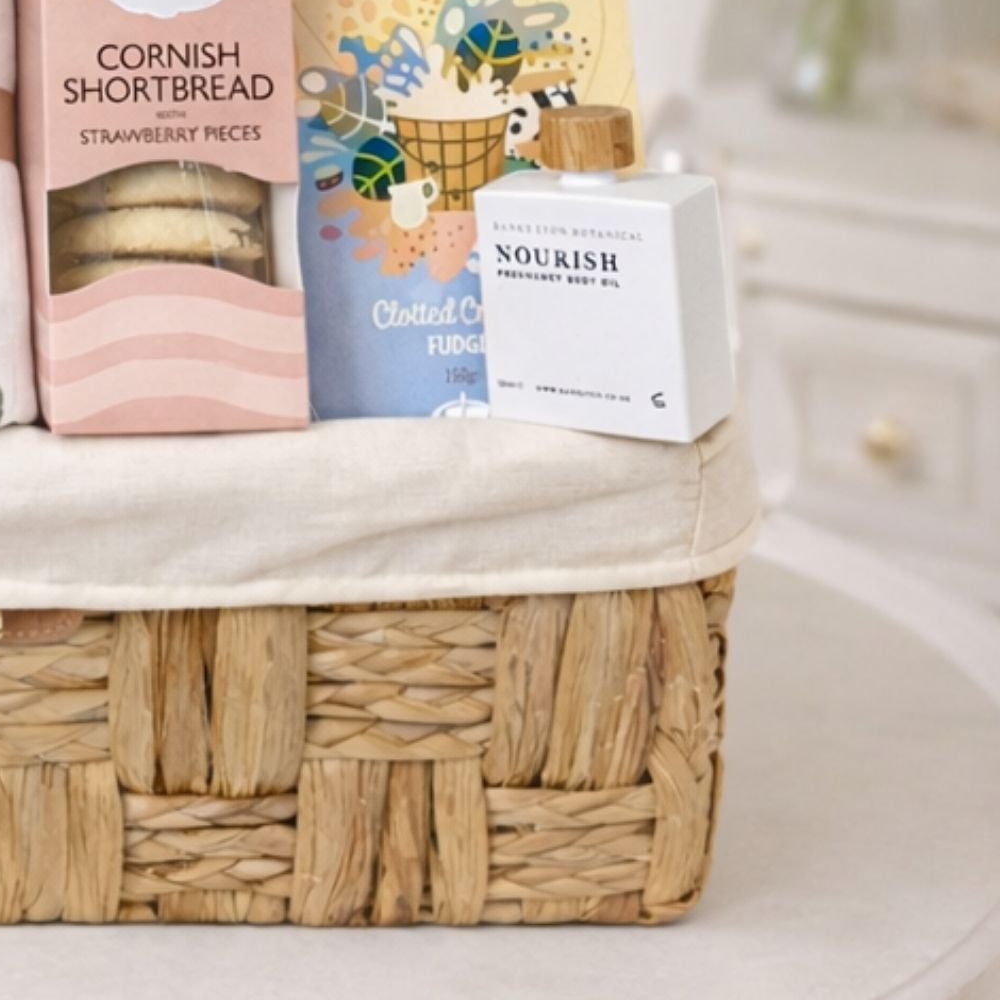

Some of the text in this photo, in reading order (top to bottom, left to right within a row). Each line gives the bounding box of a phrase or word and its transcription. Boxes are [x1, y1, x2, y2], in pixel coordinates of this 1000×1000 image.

[97, 41, 241, 71] CORNISH
[63, 73, 275, 105] SHORTBREAD
[80, 124, 262, 145] STRAWBERRY PIECES
[494, 243, 619, 273] NOURISH
[371, 297, 458, 331] Clotted
